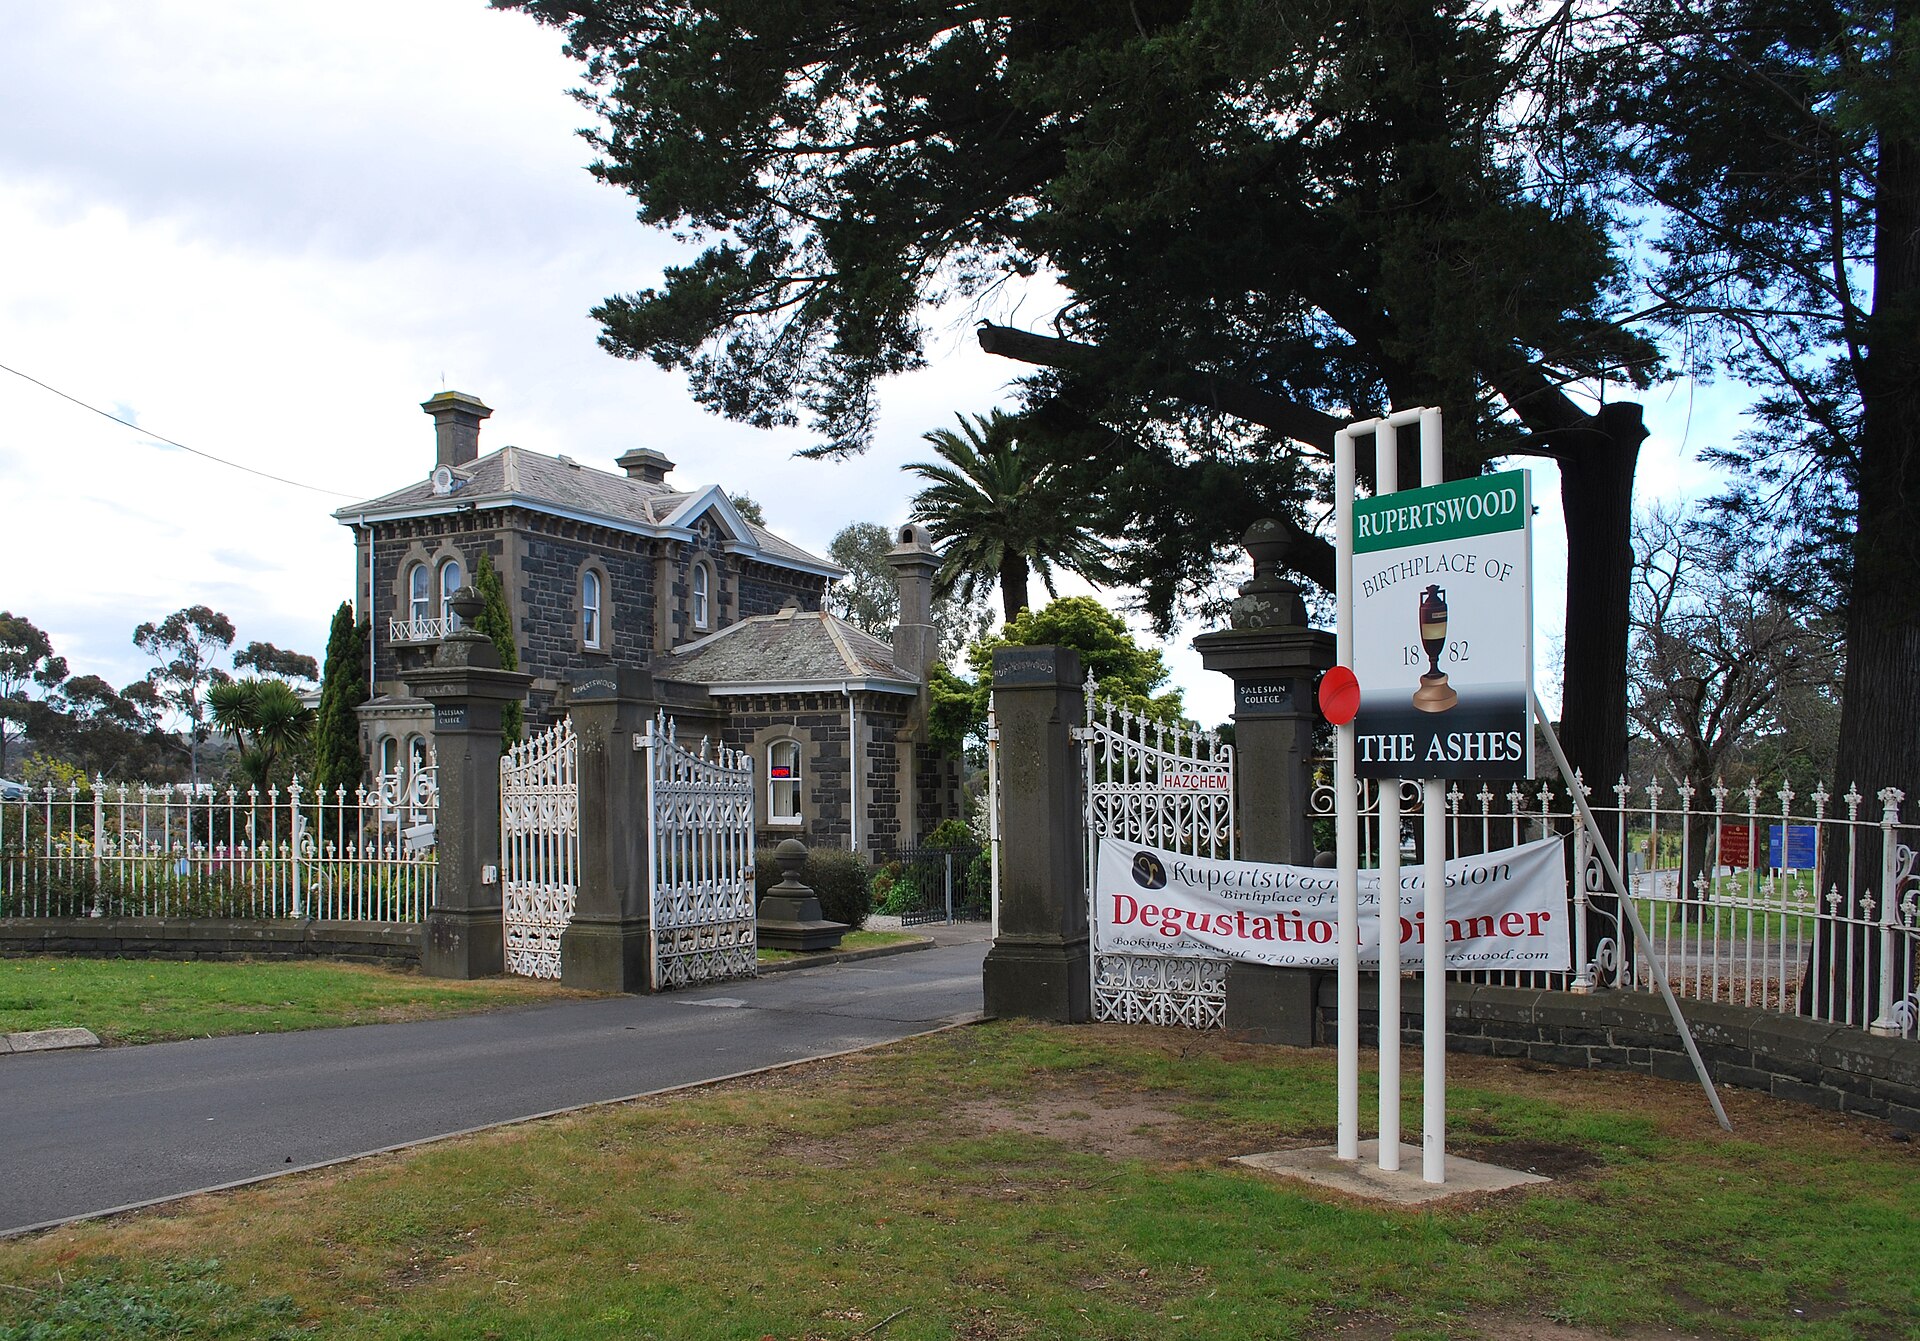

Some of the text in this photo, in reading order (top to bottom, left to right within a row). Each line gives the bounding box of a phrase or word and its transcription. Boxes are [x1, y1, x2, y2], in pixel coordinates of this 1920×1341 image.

[1358, 487, 1517, 538] RUPERTSWOOD
[1362, 553, 1513, 599] BIRTHPLACE OF
[1403, 641, 1470, 666] 18 82
[994, 661, 1053, 677] RUPWOOD
[1240, 685, 1286, 695] SALESIAN
[1244, 695, 1280, 704] COLLEGE
[1357, 731, 1523, 763] THE ASHES
[1164, 774, 1228, 790] HAZCHEM
[1172, 860, 1512, 892] Rupertswoo asion
[1220, 889, 1302, 905] Birthplace
[1307, 890, 1325, 907] of
[1358, 893, 1413, 906] Aes
[1113, 937, 1173, 950] Bookings
[1257, 952, 1296, 964] 9740
